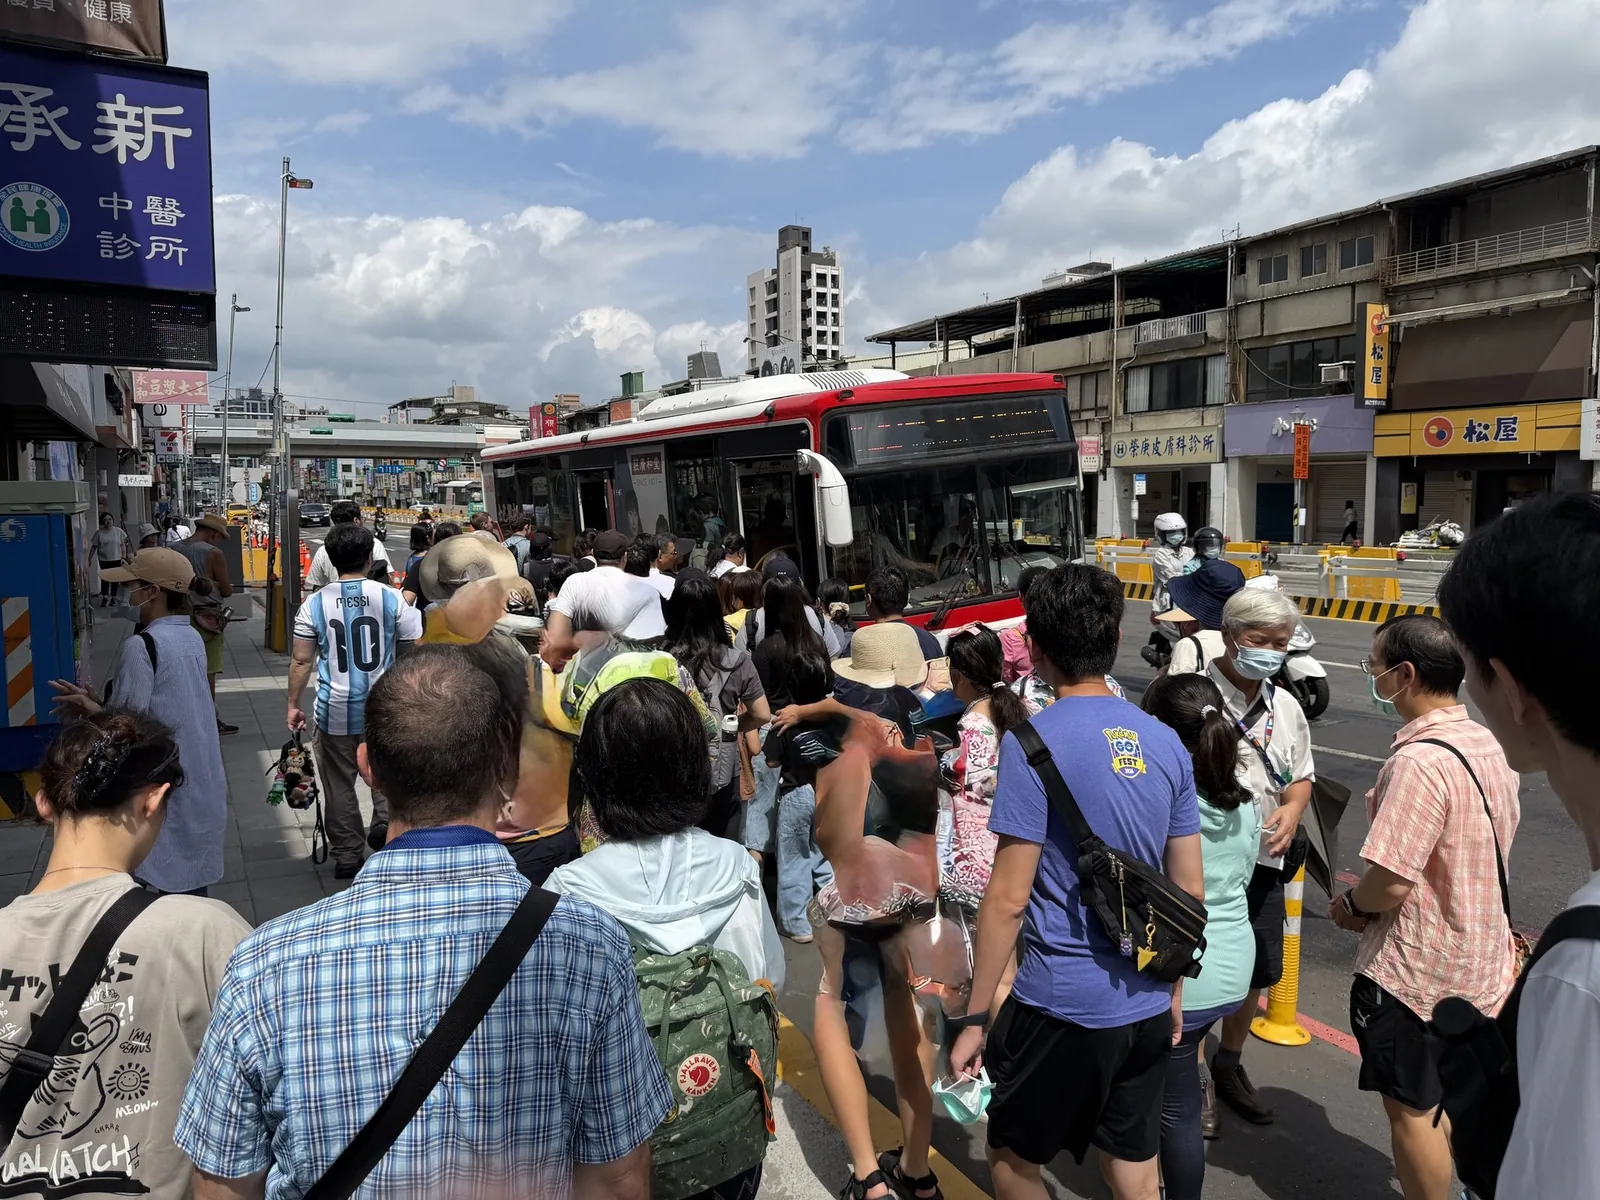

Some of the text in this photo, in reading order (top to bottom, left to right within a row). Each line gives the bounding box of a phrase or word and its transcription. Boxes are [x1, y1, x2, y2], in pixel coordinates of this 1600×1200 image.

[98, 191, 186, 228] 中醫
[96, 230, 189, 267] 診所
[1370, 342, 1385, 385] 松屋
[149, 379, 208, 397] 豆漿大王
[1463, 416, 1519, 444] 松屋
[336, 595, 370, 609] MESSI
[328, 616, 381, 673] 10
[1115, 740, 1135, 753] GO
[1118, 757, 1138, 766] FEST
